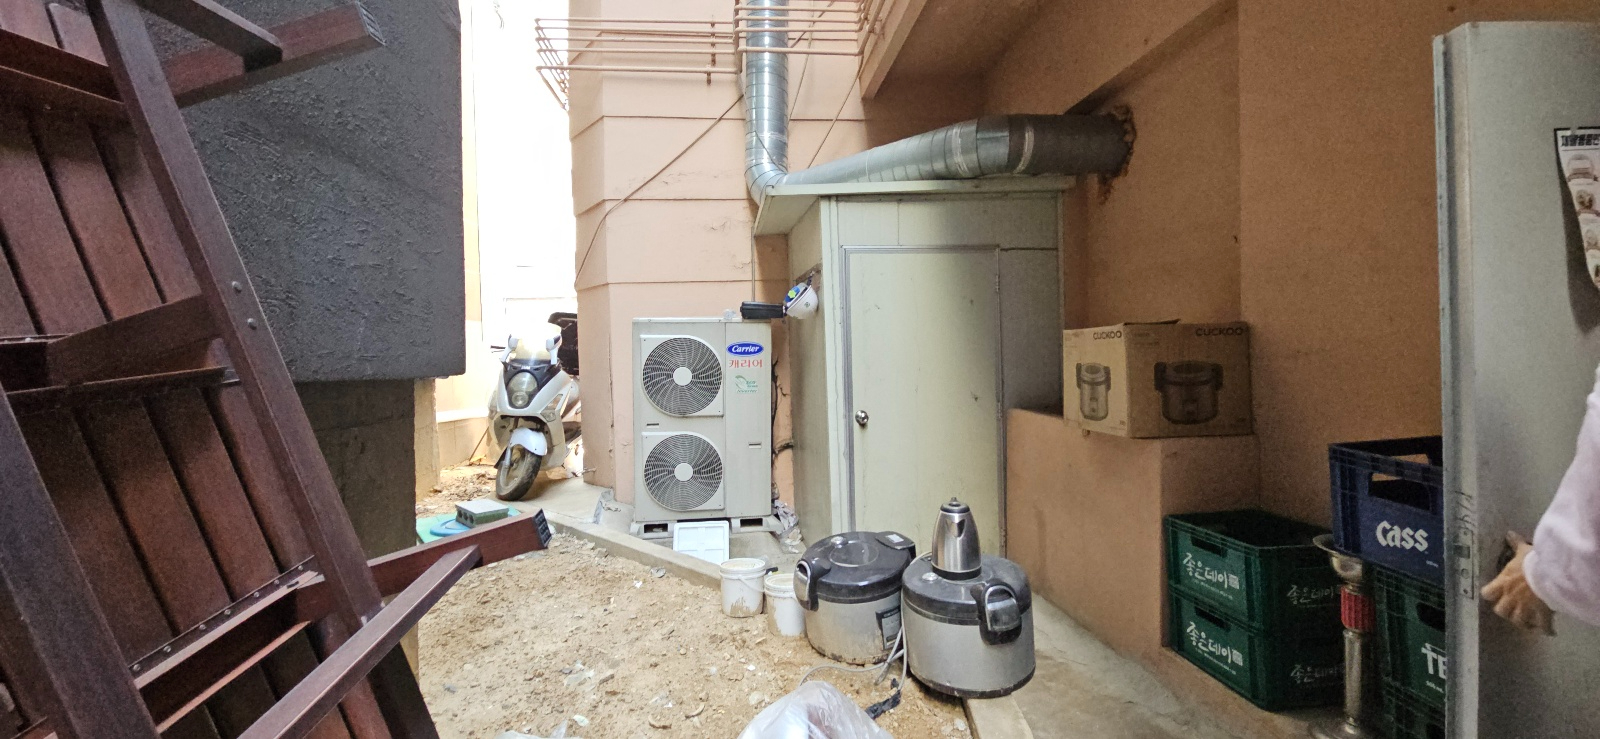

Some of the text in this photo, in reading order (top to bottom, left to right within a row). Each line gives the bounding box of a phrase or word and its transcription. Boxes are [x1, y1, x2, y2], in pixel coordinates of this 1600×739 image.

[1093, 330, 1122, 340] CUCKOO
[1195, 327, 1244, 337] CUCKOO
[731, 345, 760, 353] Carrier
[729, 359, 763, 368] 캐리어
[1376, 520, 1429, 552] Cass
[1183, 552, 1228, 589] 좋은데이
[1286, 584, 1335, 605] 좋은데이
[1186, 621, 1232, 664] 좋은데이
[1290, 664, 1338, 684] 좋은데이
